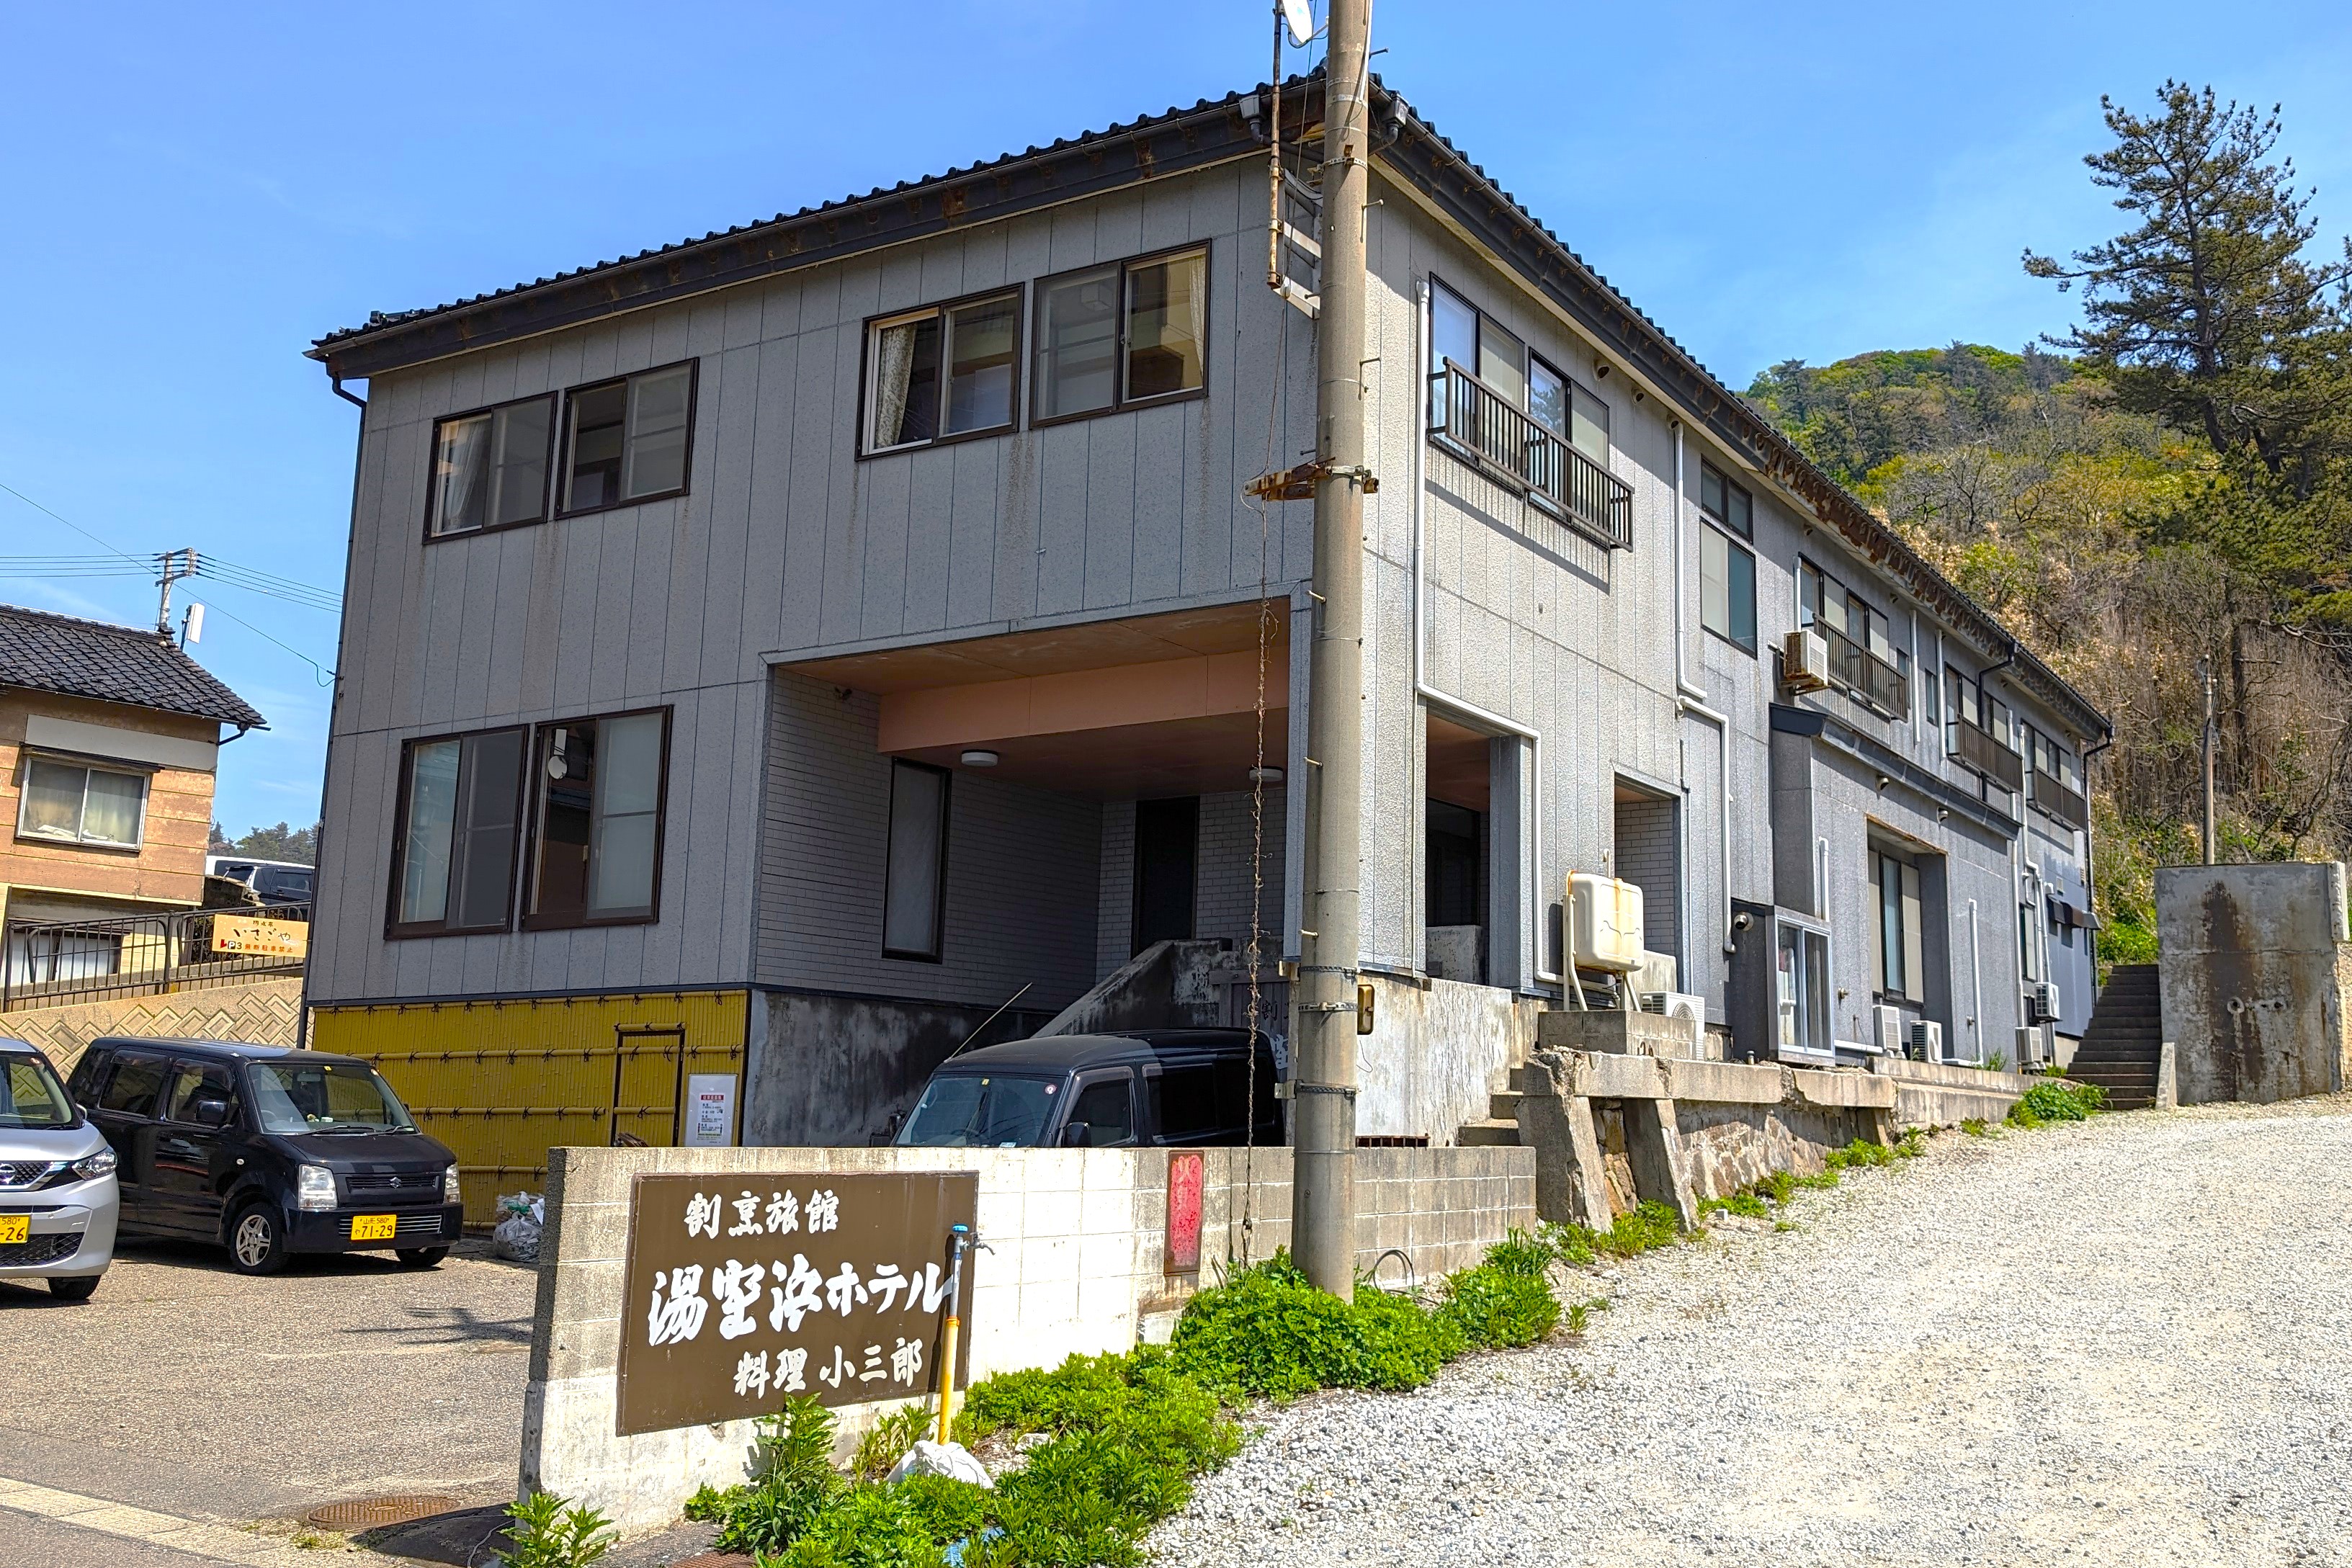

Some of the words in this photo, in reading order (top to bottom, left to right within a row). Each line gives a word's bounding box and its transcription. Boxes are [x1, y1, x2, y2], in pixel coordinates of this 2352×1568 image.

[233, 928, 291, 941] いさごや
[684, 1188, 840, 1240] 割烹旅館
